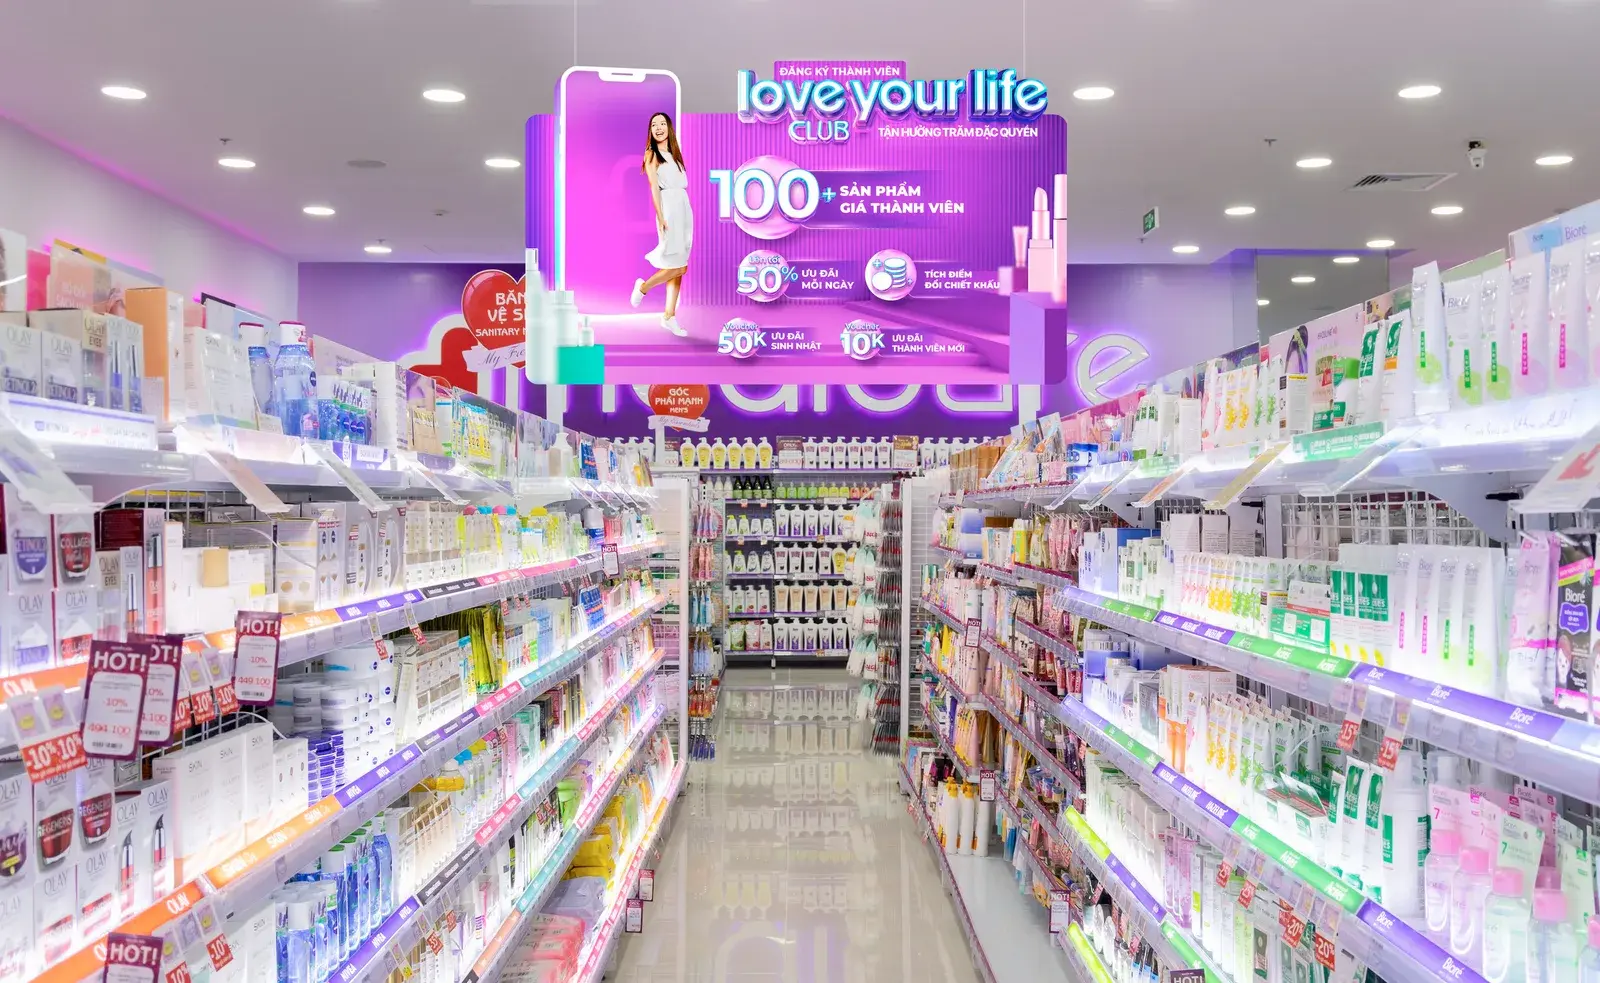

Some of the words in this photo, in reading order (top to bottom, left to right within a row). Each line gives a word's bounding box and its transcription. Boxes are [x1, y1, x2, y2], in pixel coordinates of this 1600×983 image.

[779, 66, 812, 76] ĐĂNG
[815, 65, 828, 76] KÝ
[832, 65, 871, 76] THÀNH
[874, 66, 900, 76] VIÊN
[737, 69, 847, 116] love
[848, 78, 967, 128] your
[970, 68, 1049, 118] life
[789, 120, 850, 143] CLUB
[878, 126, 900, 140] TẬN
[942, 125, 975, 138] TRĂM
[975, 125, 998, 140] ĐẶC
[840, 182, 872, 197] SẢN
[875, 181, 921, 197] PHẨM
[840, 200, 867, 214] GIÁ
[871, 200, 925, 214] THÀNH
[928, 200, 965, 214] VIÊN
[736, 265, 799, 295] 50%
[801, 268, 817, 278] ƯU
[819, 268, 839, 278] ĐÃI
[924, 268, 946, 278] TÍCH
[801, 278, 822, 290] MỖI
[825, 279, 855, 290] NGÀY
[944, 279, 972, 289] CHIẾT
[487, 306, 508, 325] VỆ
[6, 325, 32, 346] OLAY
[475, 327, 520, 337] SANITARY
[724, 322, 759, 331] Voucher
[845, 322, 880, 332] Voucher
[717, 331, 768, 355] 50K
[771, 332, 784, 341] ƯU
[786, 332, 805, 341] ĐÃI
[840, 332, 885, 356] 10K
[892, 334, 906, 342] ƯU
[908, 334, 923, 342] ĐÃI
[771, 342, 794, 350] SINH
[796, 342, 822, 352] NHẬT
[892, 343, 922, 353] THÀNH
[925, 344, 949, 353] VIÊN
[950, 343, 965, 353] MỚI
[668, 387, 689, 396] GÓC
[655, 396, 676, 405] PHÁI
[677, 397, 703, 407] MẠNH
[99, 556, 119, 573] OLAY
[104, 576, 117, 587] EYES
[18, 594, 44, 613] OLAY
[66, 590, 88, 607] OLAY
[239, 619, 280, 635] HOT!
[93, 650, 147, 673] HOT!
[217, 685, 236, 706] -10%
[1431, 684, 1453, 700] Bioré
[175, 699, 191, 721] 10%
[194, 690, 213, 714] -10%
[1509, 706, 1537, 726] Bioré
[1340, 722, 1359, 741] -15%
[26, 741, 57, 771] -10%
[188, 760, 203, 773] SKIN
[148, 788, 170, 807] OLAY
[117, 802, 140, 822] OLAY
[86, 850, 108, 874] OLAY
[43, 869, 69, 896] OLAY
[166, 892, 190, 914] OLAY
[1050, 893, 1070, 902] HOT!
[1286, 918, 1304, 937] -20%
[1376, 910, 1396, 929] Bioré
[110, 942, 158, 966] HOT!
[211, 935, 228, 960] -10%
[1315, 937, 1334, 959] -20%
[1442, 956, 1465, 979] Bioré
